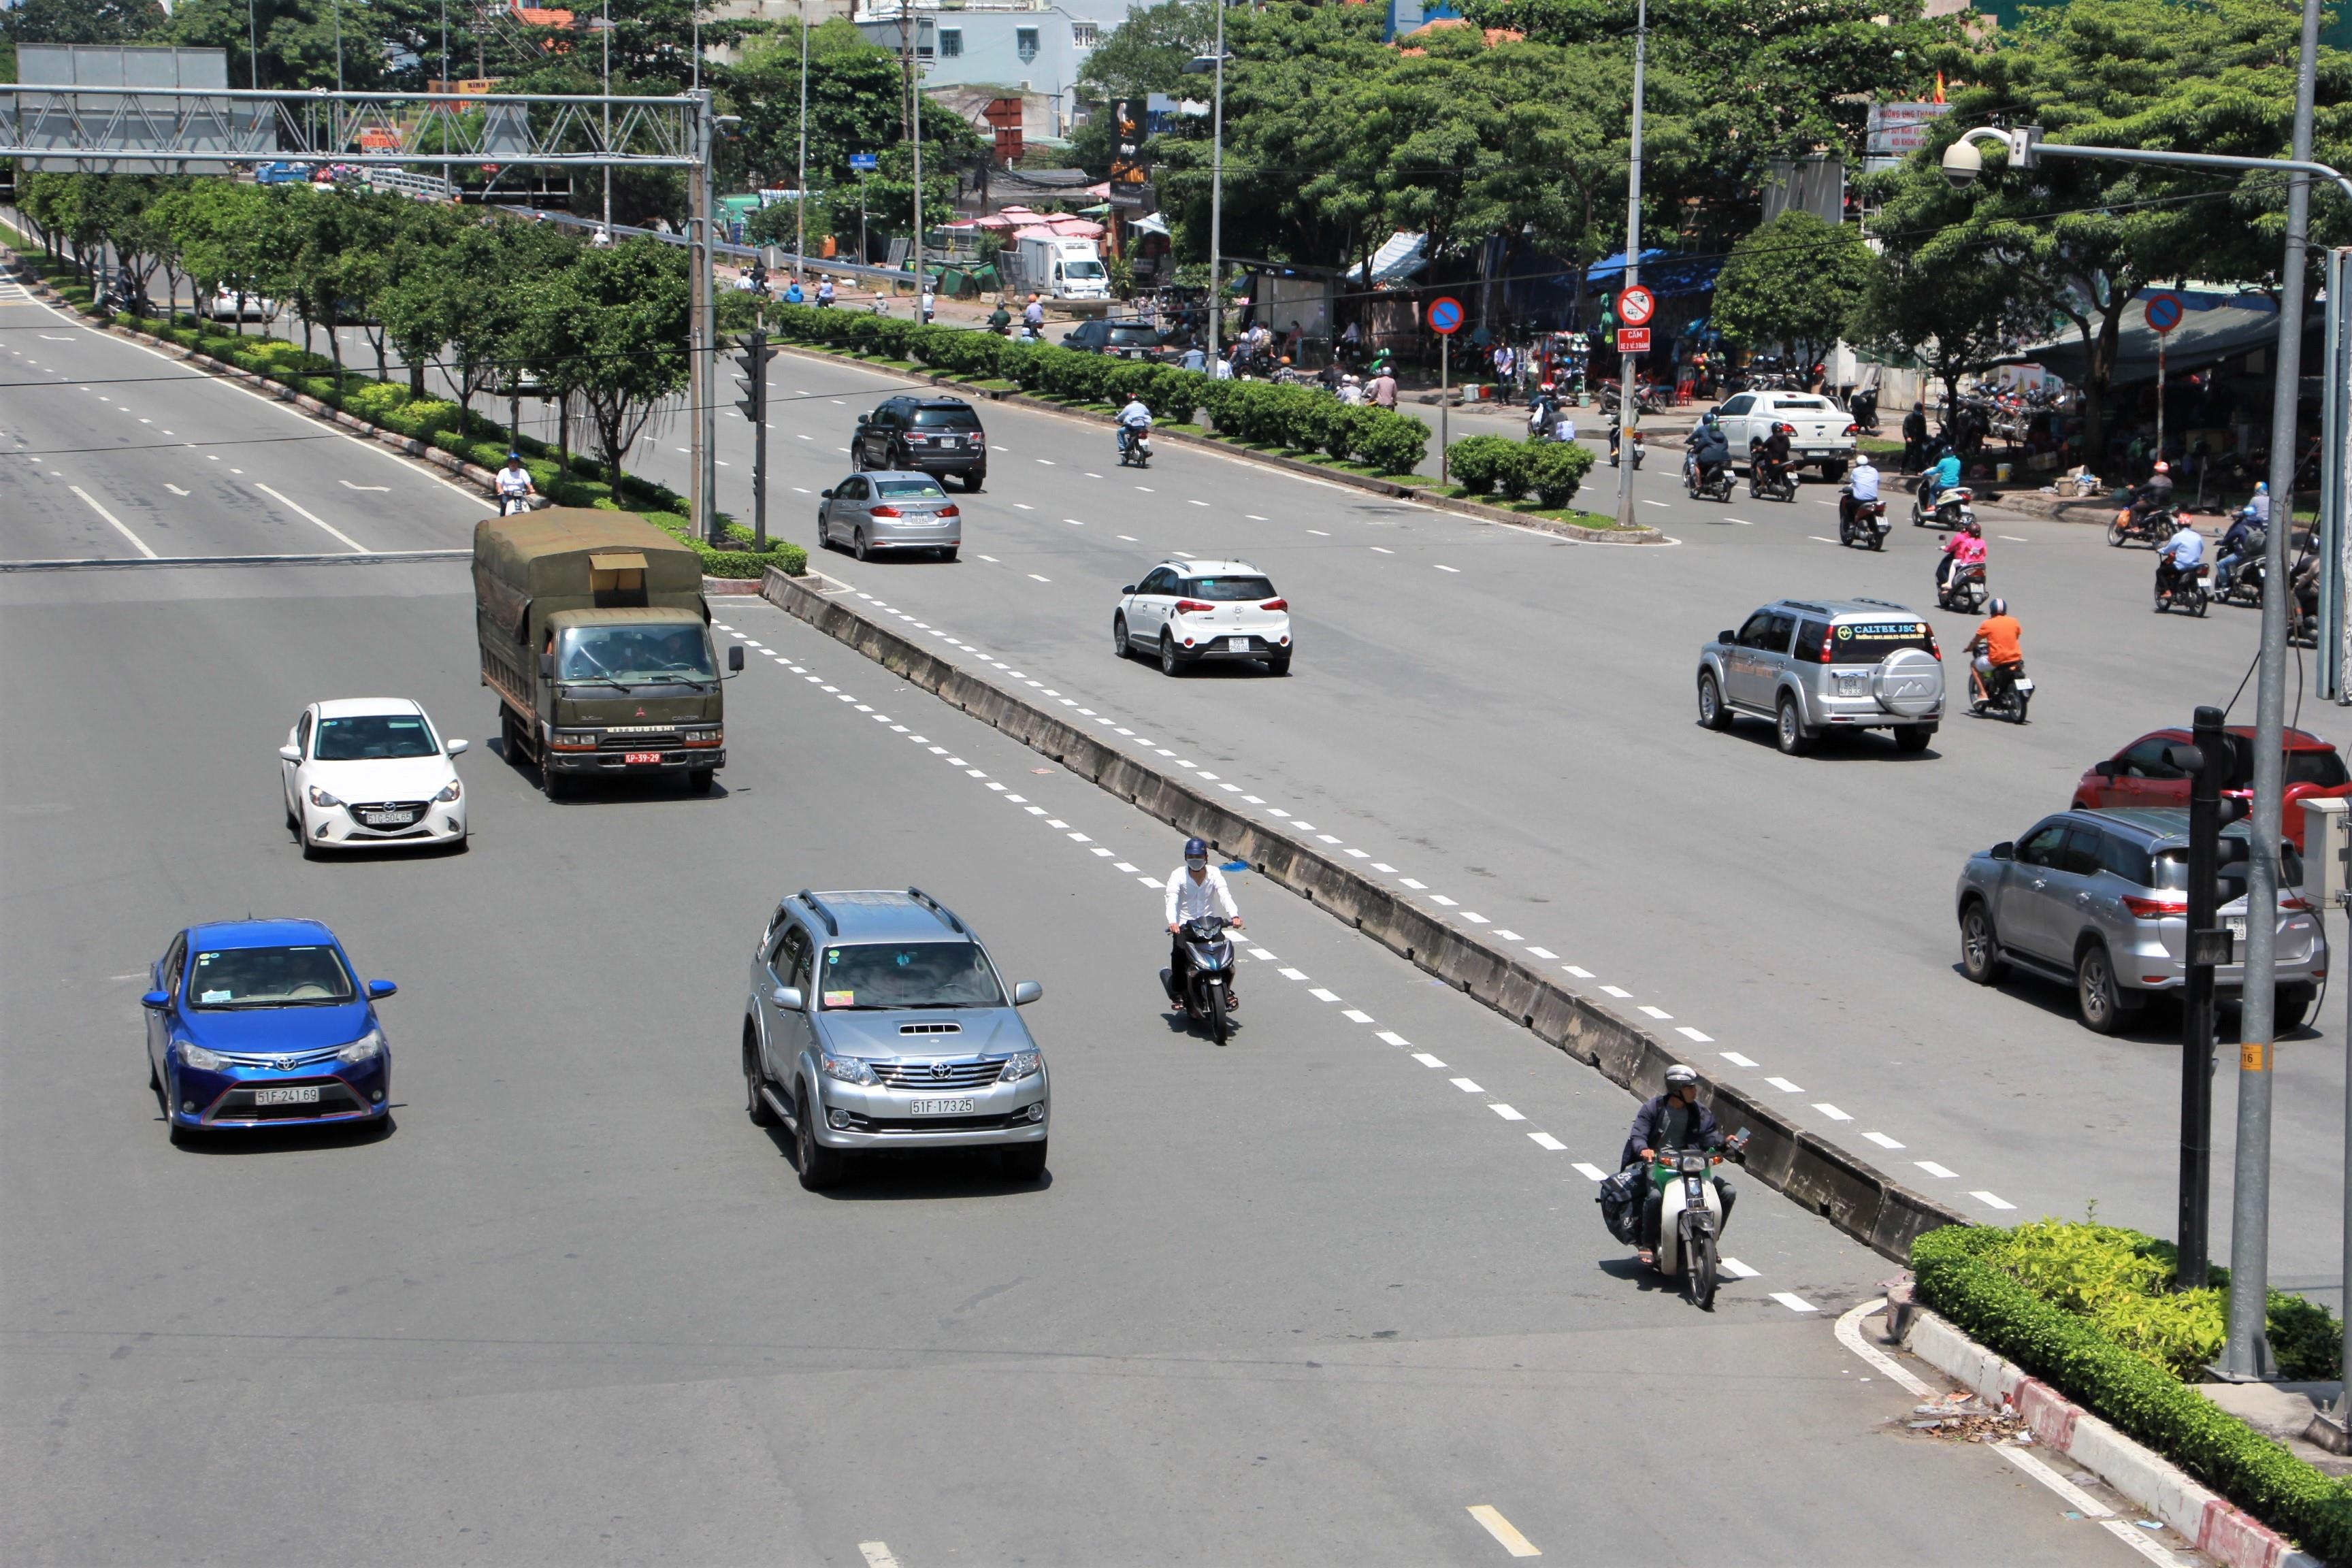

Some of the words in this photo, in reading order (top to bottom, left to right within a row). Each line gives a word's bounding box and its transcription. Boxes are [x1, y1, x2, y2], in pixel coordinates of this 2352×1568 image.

[1898, 625, 1916, 633] JSC
[625, 753, 660, 763] KP-39-29
[258, 1090, 316, 1102] 51F-241.69
[913, 1100, 972, 1113] 51F-173.25
